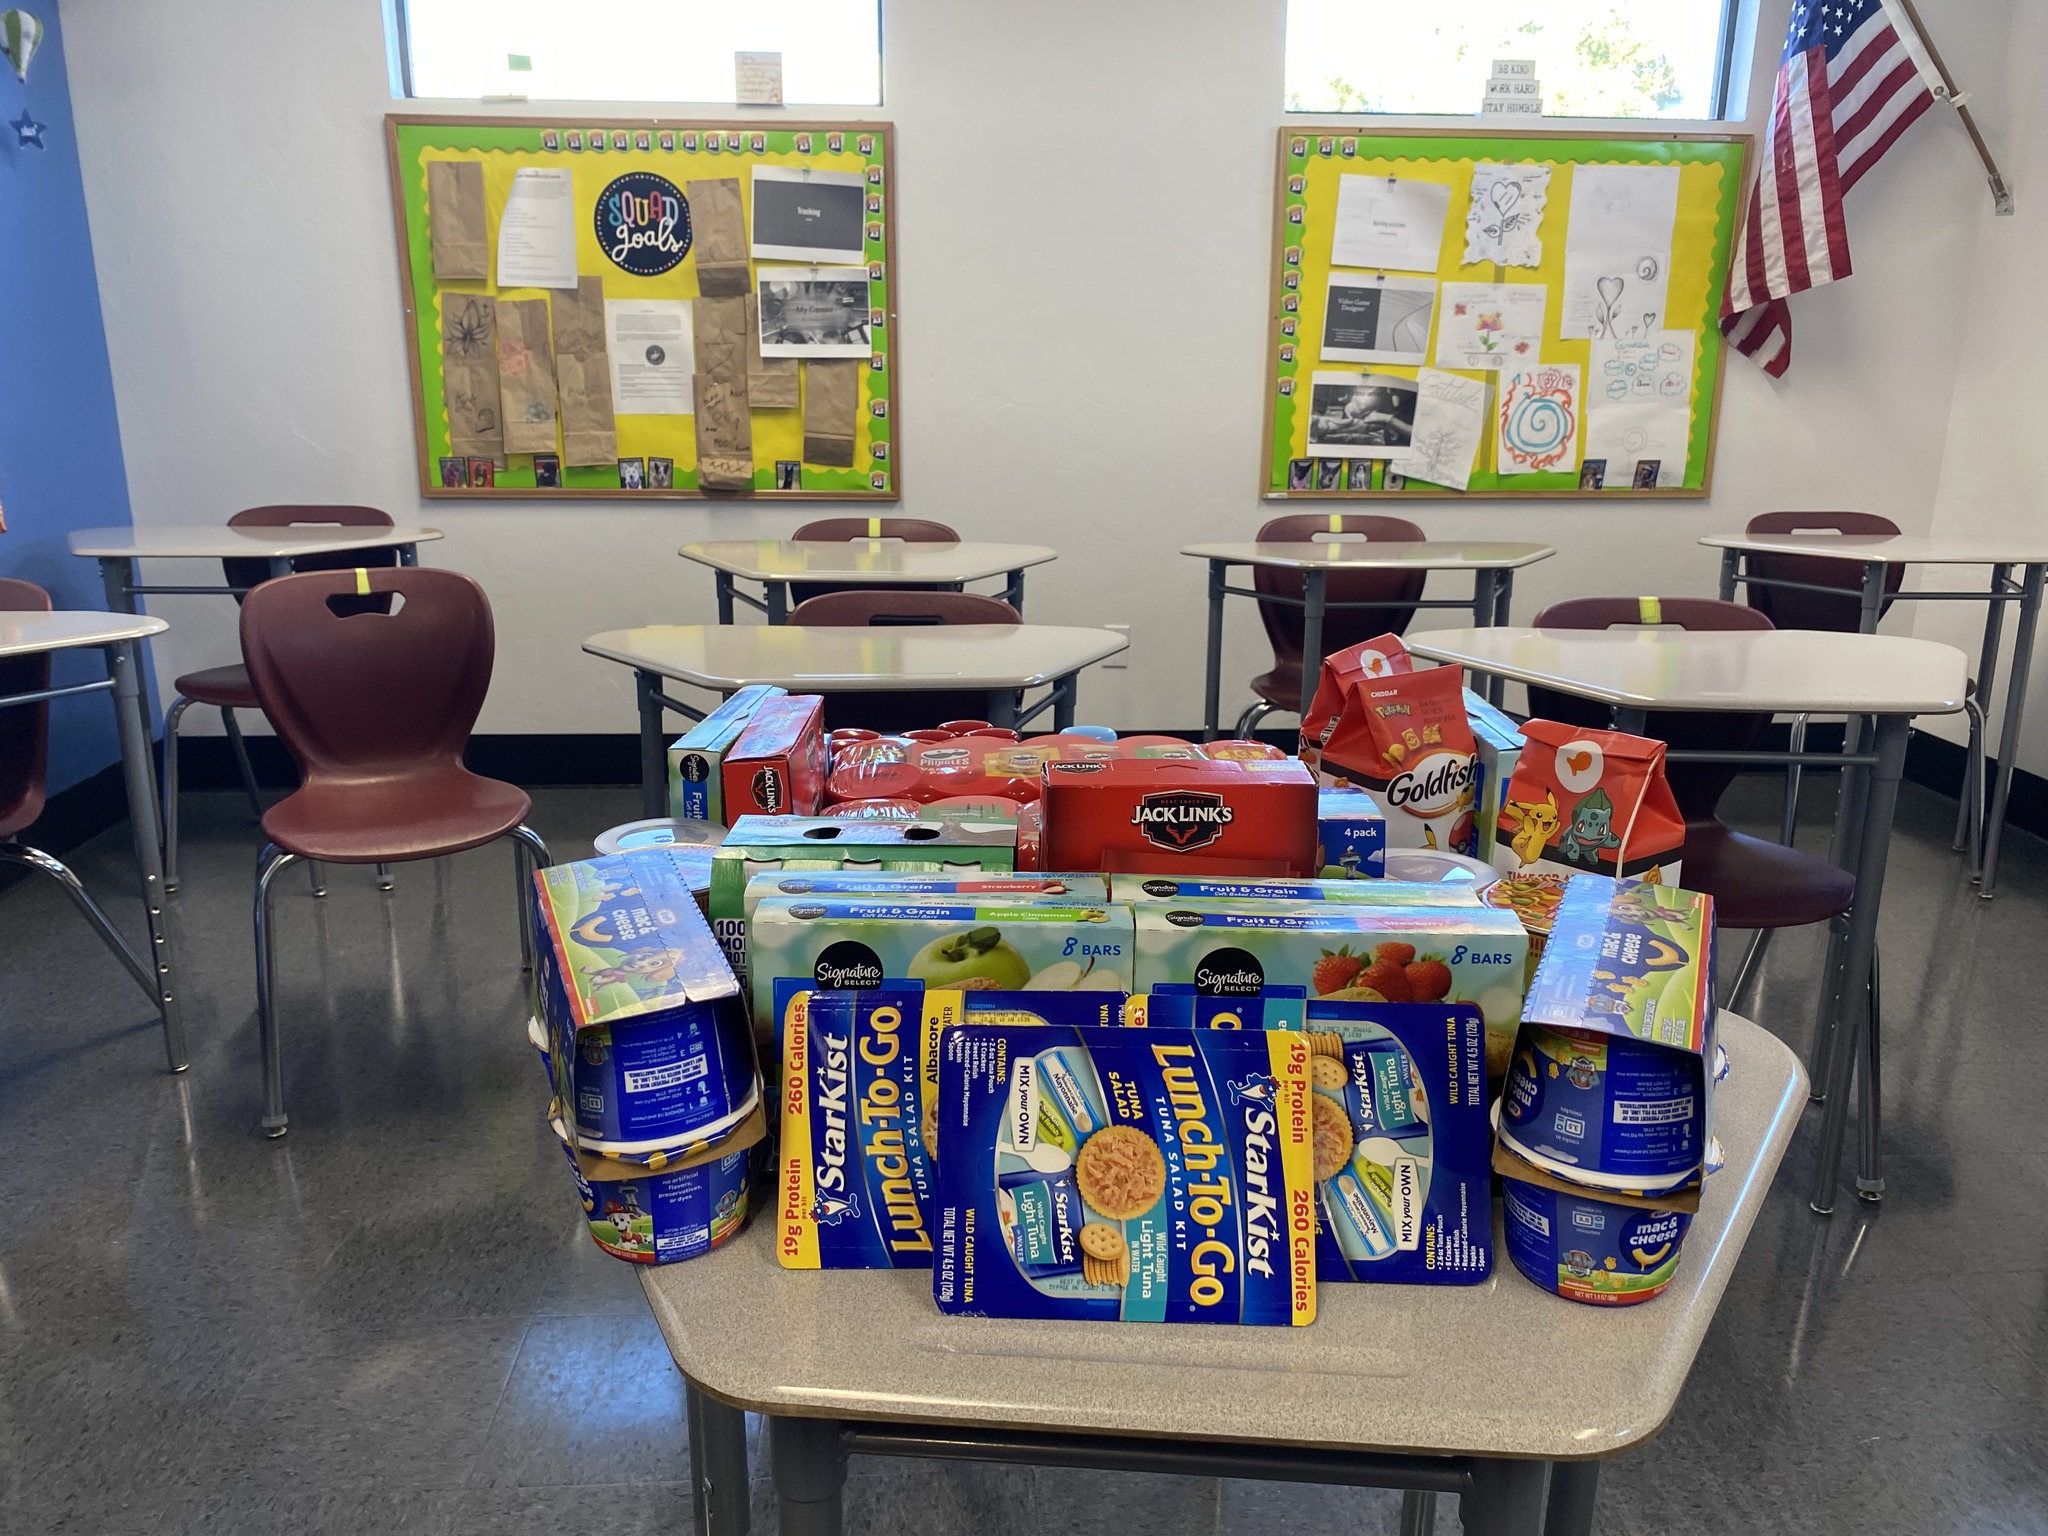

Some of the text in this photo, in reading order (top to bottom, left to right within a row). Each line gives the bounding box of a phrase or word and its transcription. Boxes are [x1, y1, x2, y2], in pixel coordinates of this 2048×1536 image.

[1490, 83, 1536, 94] WORK HARD
[1498, 64, 1530, 74] BE KIND
[1482, 103, 1541, 113] STAY HUMBLE
[608, 191, 679, 227] SQUAD
[797, 206, 821, 218] Trucking
[611, 217, 683, 262] goals
[1341, 305, 1366, 313] Designer
[1370, 689, 1398, 698] CHEDDAR
[763, 765, 774, 788] JACK
[920, 758, 970, 766] PRINGLES
[1387, 754, 1478, 806] Goldfish
[692, 791, 703, 820] Fruit
[1131, 805, 1233, 824] JACK LINK'S
[1344, 827, 1377, 839] 4 pack
[1200, 885, 1237, 893] Fruit
[1254, 887, 1298, 895] Grain
[630, 907, 650, 927] mac
[1227, 916, 1330, 926] Fruit & Grain
[1062, 937, 1121, 957] 8 BARS
[1451, 945, 1512, 965] 8 BARS
[1603, 941, 1619, 959] mac
[817, 962, 881, 988] Signature
[1197, 968, 1262, 994] Signature
[787, 1003, 806, 1115] 260 Calories
[926, 1016, 939, 1085] Albacore
[947, 1041, 955, 1061] Spoon
[980, 1048, 988, 1073] Crackers
[996, 1038, 1007, 1085] CONTAINS:
[1446, 1016, 1458, 1105] WILD CAUGHT TUNA
[1465, 1017, 1480, 1106] TOTAL NET WT 4.5 OZ (128g)
[962, 1041, 972, 1127] Reduced-Calorie Mayonnaise
[1052, 1072, 1078, 1115] Mayonnaise
[1108, 1071, 1130, 1118] SALAD
[1124, 1081, 1144, 1120] TUNA
[1287, 1043, 1308, 1144] 19g Protein
[1352, 1052, 1374, 1120] StarKist
[1386, 1057, 1406, 1121] Light Tuna
[816, 1032, 849, 1192] StarKist
[1018, 1065, 1030, 1144] MIX your OWN
[903, 1055, 931, 1200] TUNA SALAD KIT
[1568, 1123, 1579, 1132] 3.5
[658, 1184, 702, 1198] preservatives,
[668, 1181, 693, 1191] flavors,
[671, 1171, 699, 1184] artificial
[1155, 1096, 1187, 1250] TUNA SALAD KIT
[677, 1195, 693, 1203] dyes
[783, 1158, 802, 1257] 19g Protein
[1245, 1107, 1277, 1279] StarKist
[1400, 1164, 1413, 1243] MIX your OWN
[1021, 1191, 1040, 1259] Light Tuna
[1054, 1192, 1075, 1262] StarKist
[1352, 1192, 1379, 1234] Mayonnaise
[1636, 1216, 1678, 1235] mac &
[939, 1206, 956, 1303] TOTAL NET WT 4.5 OZ (128g)
[964, 1208, 975, 1303] WILD CAUGHT TUNA
[1131, 1248, 1141, 1273] WATER
[1139, 1220, 1154, 1299] Light Tuna
[1155, 1232, 1167, 1283] Wild Caught
[1293, 1190, 1312, 1312] 260 Calories
[1425, 1223, 1436, 1270] CONTAINS:
